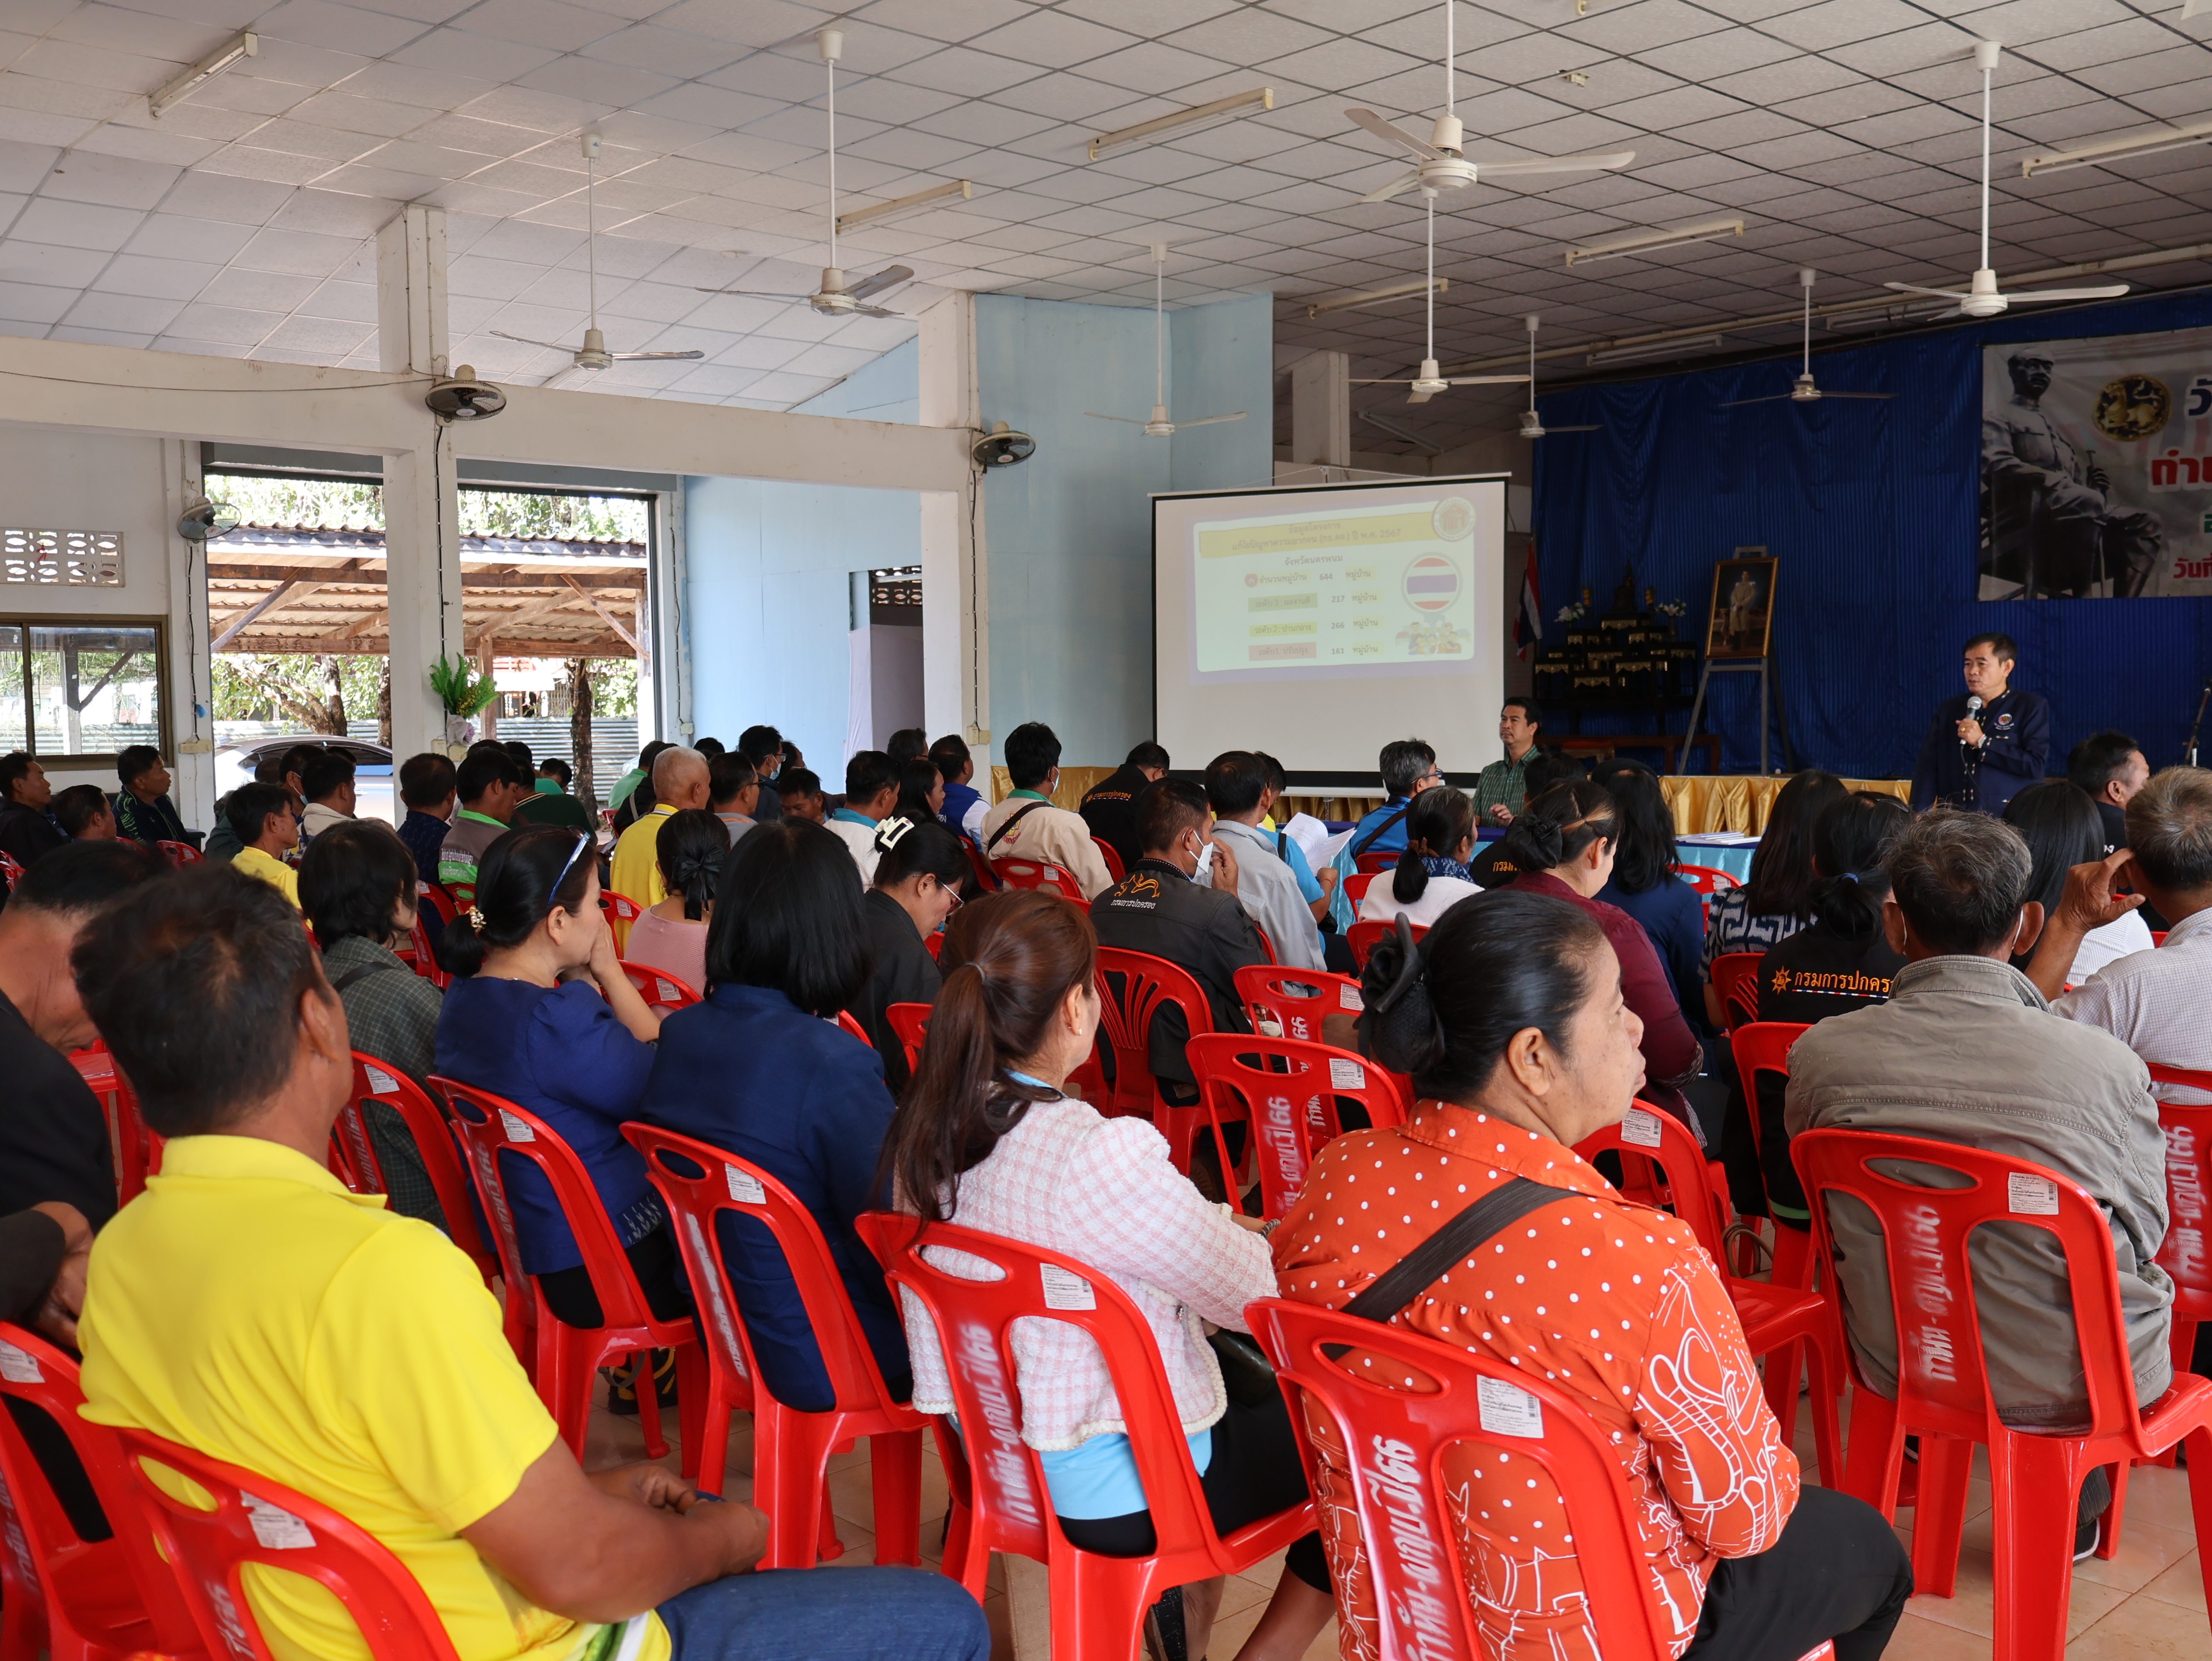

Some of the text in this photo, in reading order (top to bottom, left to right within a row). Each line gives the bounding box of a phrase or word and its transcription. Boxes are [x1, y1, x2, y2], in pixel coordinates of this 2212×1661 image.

[1380, 528, 1401, 538] 2567
[1285, 554, 1343, 566] จังหวัดนครพนม
[1259, 572, 1307, 584] จำนวนหมู่บ้าน
[1346, 569, 1371, 581] หมู่บ้าน
[1351, 593, 1377, 604] หมู่บ้าน
[1353, 619, 1378, 630] หมู่บ้าน
[1352, 644, 1378, 656] หมู่บ้าน
[1111, 899, 1156, 909] กรมการปกครอง
[1794, 970, 1894, 993] กรมการปกคร
